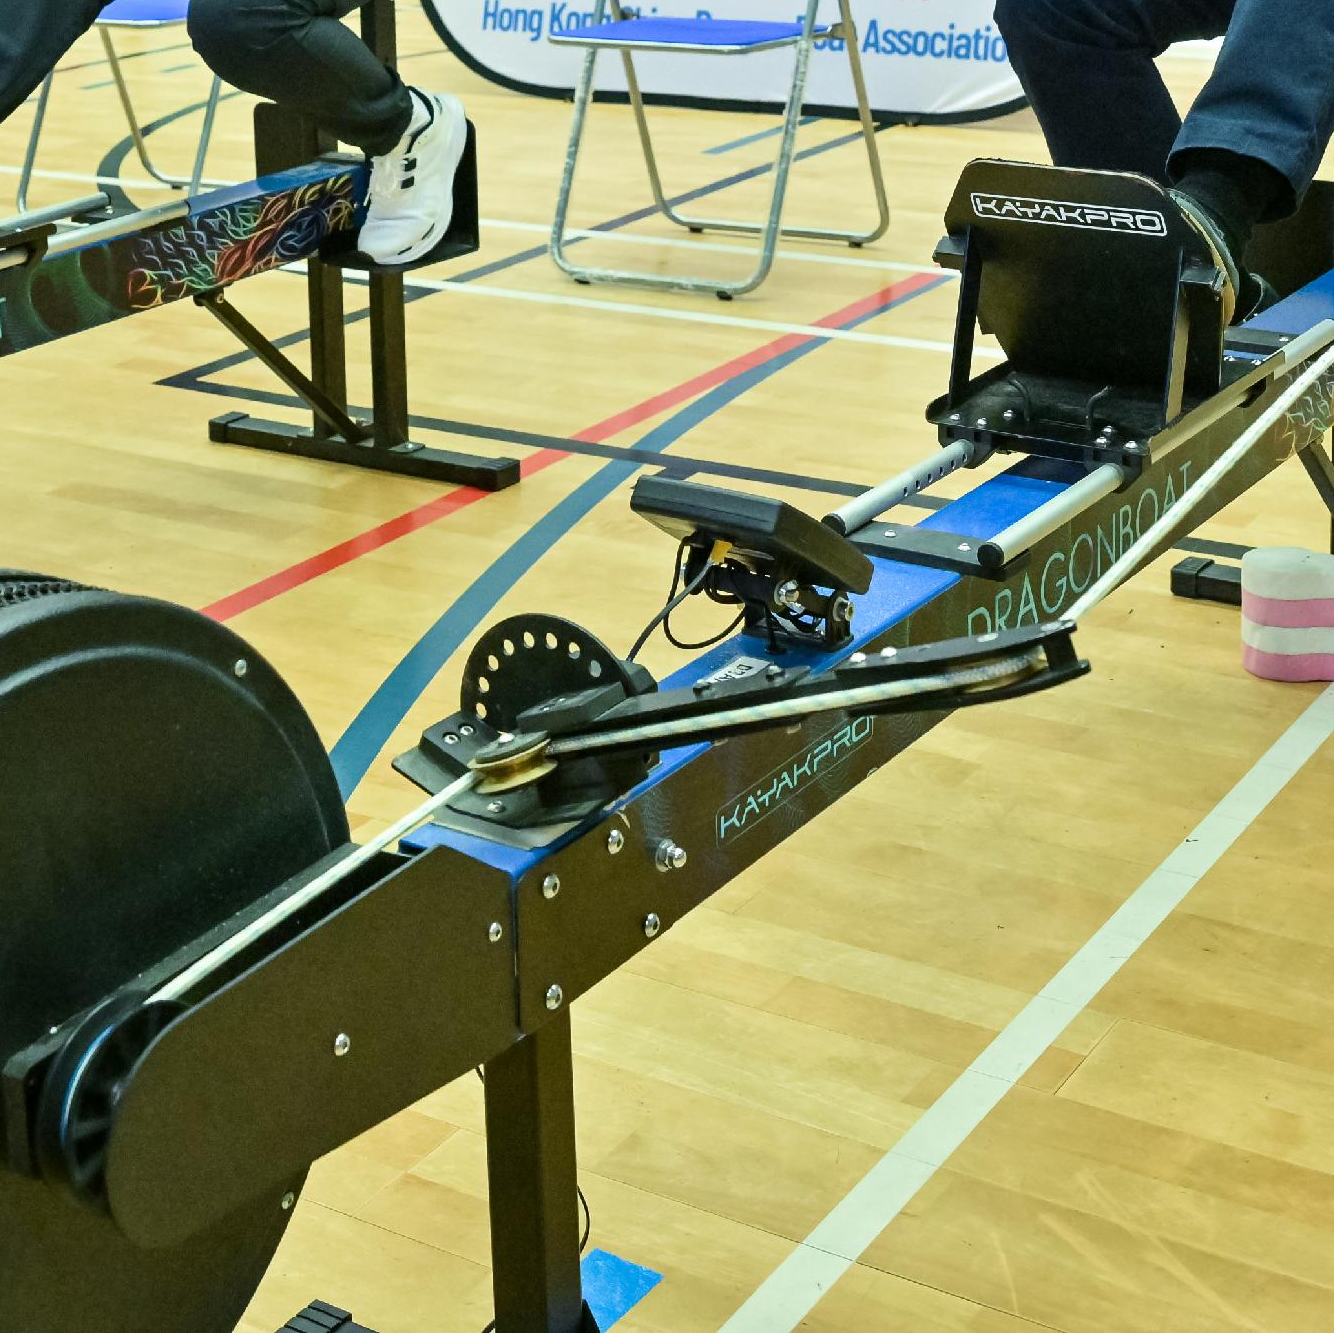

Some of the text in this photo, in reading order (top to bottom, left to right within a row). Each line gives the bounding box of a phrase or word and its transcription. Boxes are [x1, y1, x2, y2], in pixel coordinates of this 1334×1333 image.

[483, 0, 543, 43] Hong
[862, 19, 1005, 62] Associatio
[975, 196, 1165, 233] KAYAKPRO
[719, 713, 873, 839] KAYAKPRO
